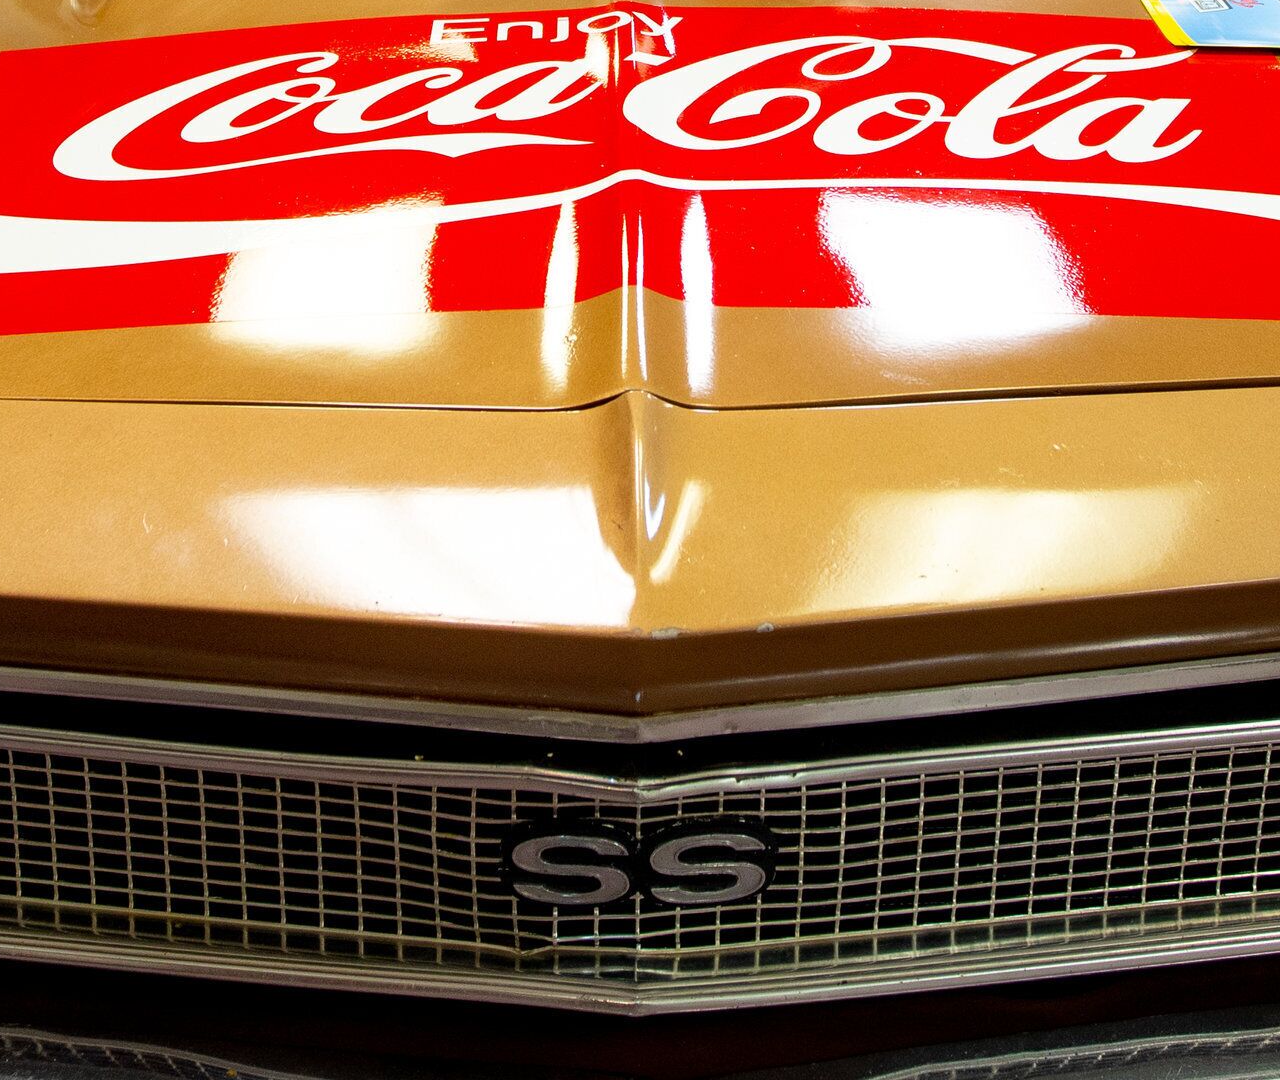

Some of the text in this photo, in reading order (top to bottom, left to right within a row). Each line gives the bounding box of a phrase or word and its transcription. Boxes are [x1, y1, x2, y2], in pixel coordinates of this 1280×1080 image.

[431, 10, 685, 56] Enjoy
[53, 35, 1204, 182] Coca-Cola
[510, 832, 768, 906] SS
